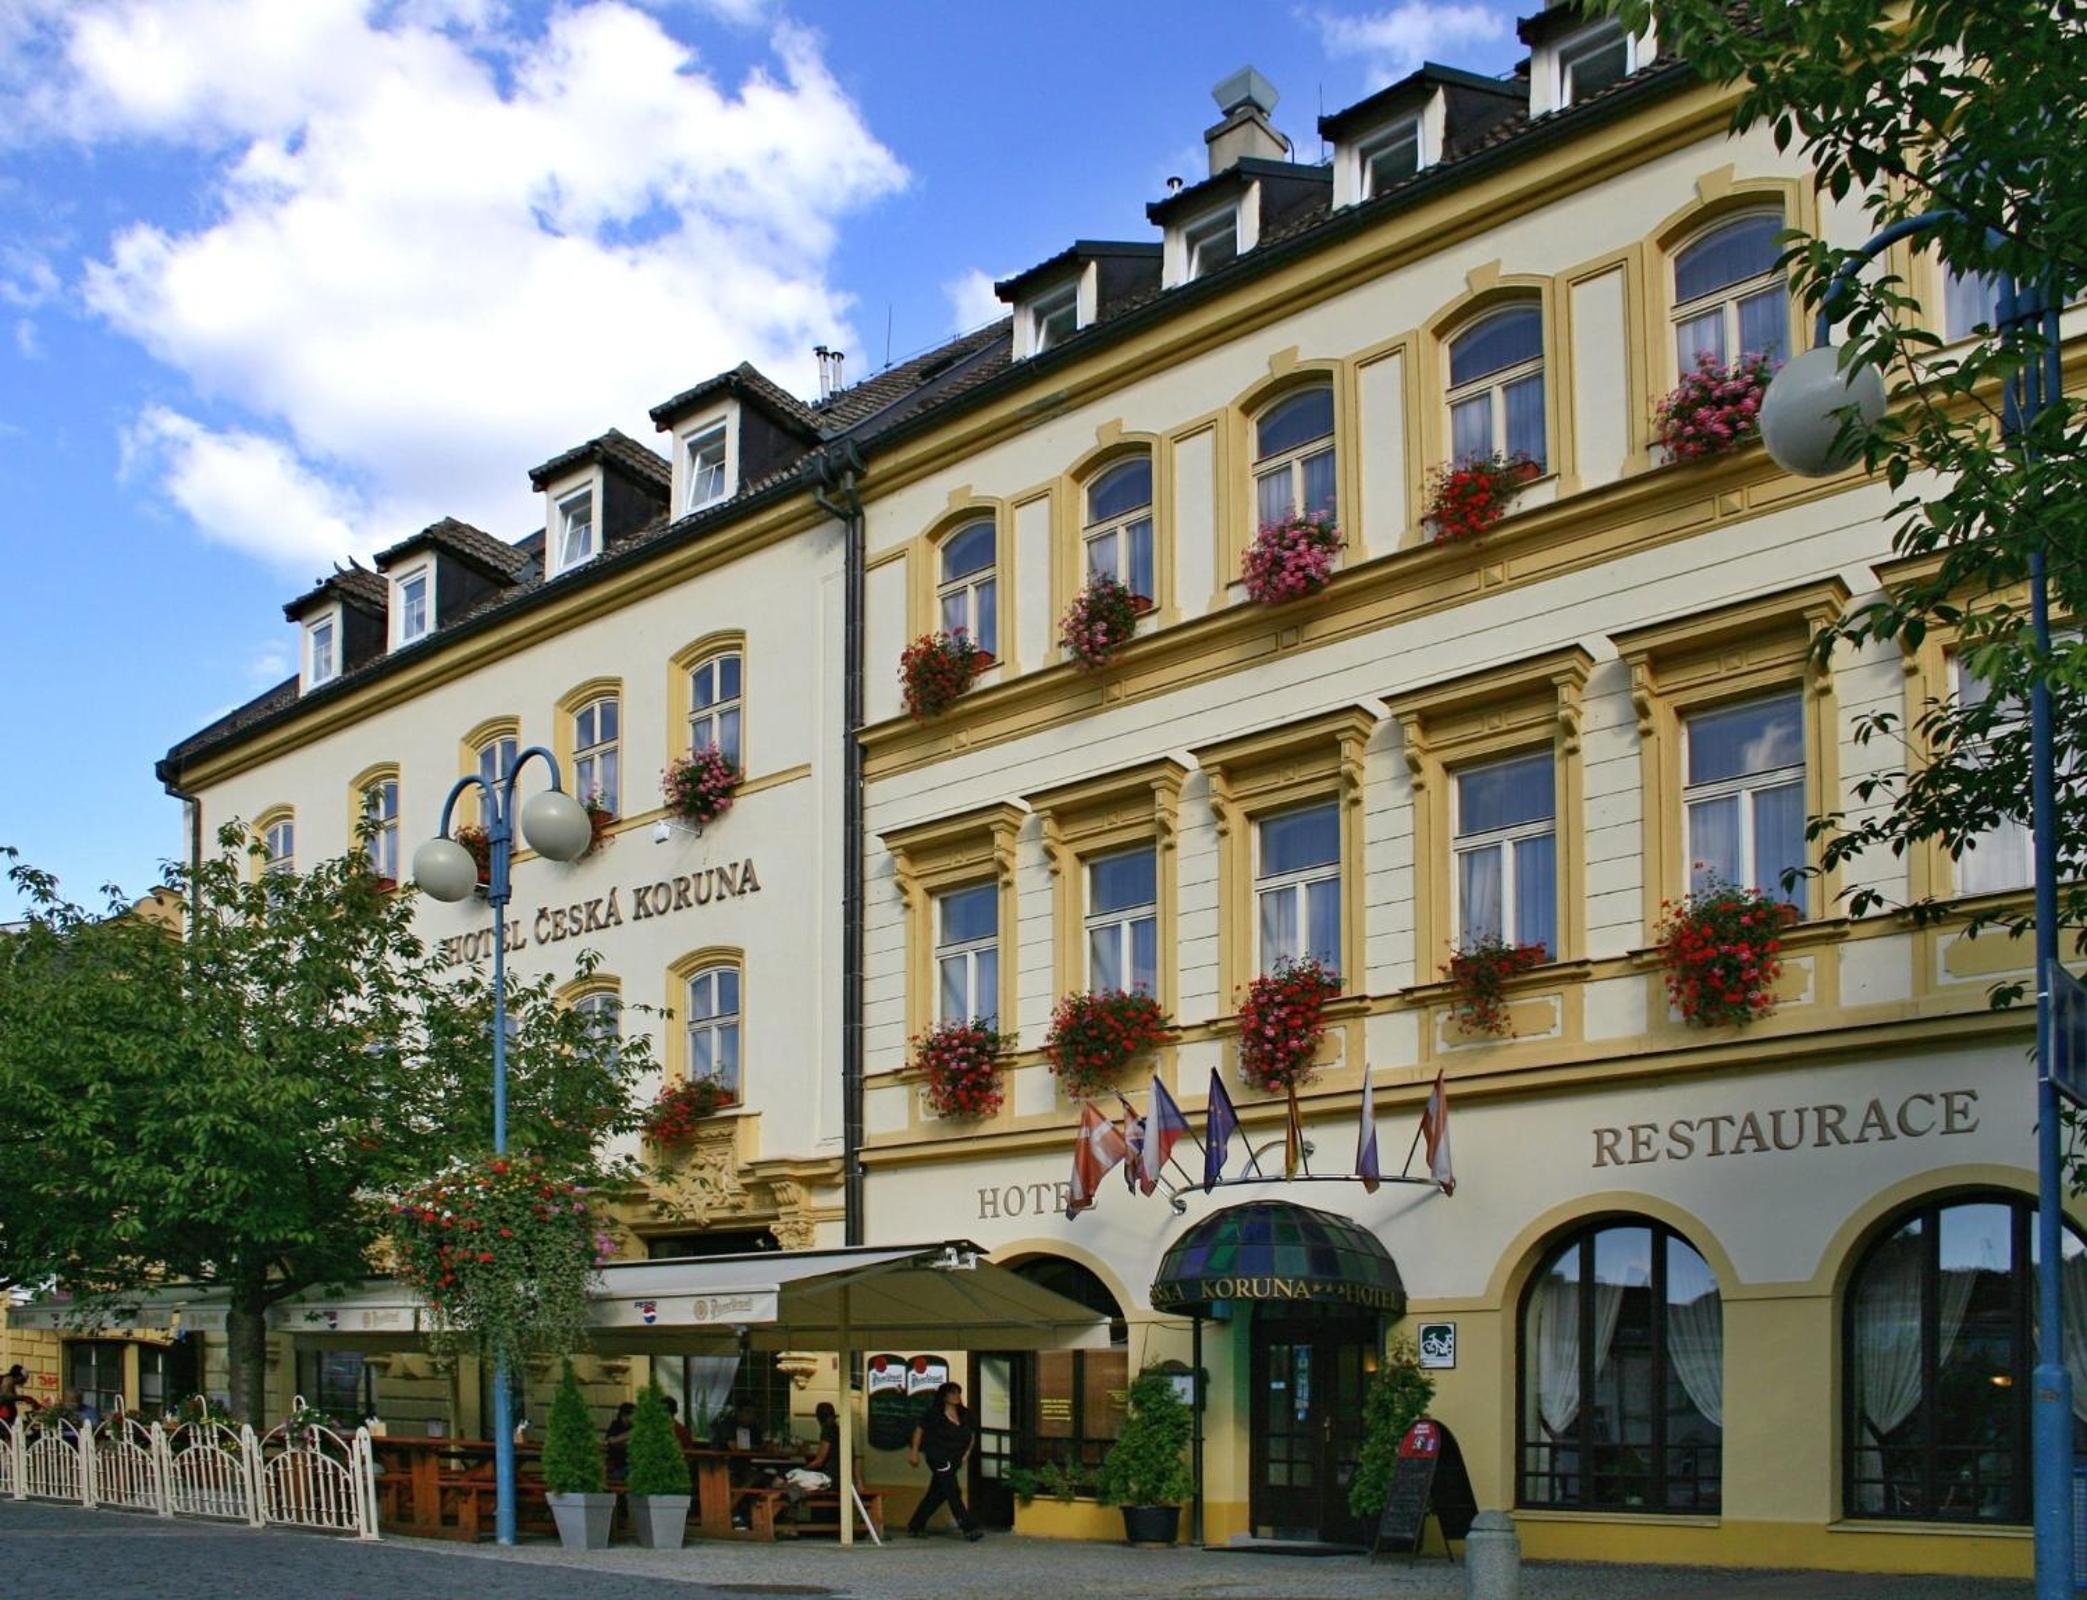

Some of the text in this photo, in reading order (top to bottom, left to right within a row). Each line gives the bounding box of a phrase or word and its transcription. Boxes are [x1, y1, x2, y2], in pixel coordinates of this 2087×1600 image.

[534, 887, 623, 945] ČESKÁ
[632, 858, 761, 920] KORUNA
[1592, 1089, 1980, 1168] RESTAURACE
[978, 1181, 1098, 1219] HOTE
[1201, 1278, 1313, 1300] KORUNA
